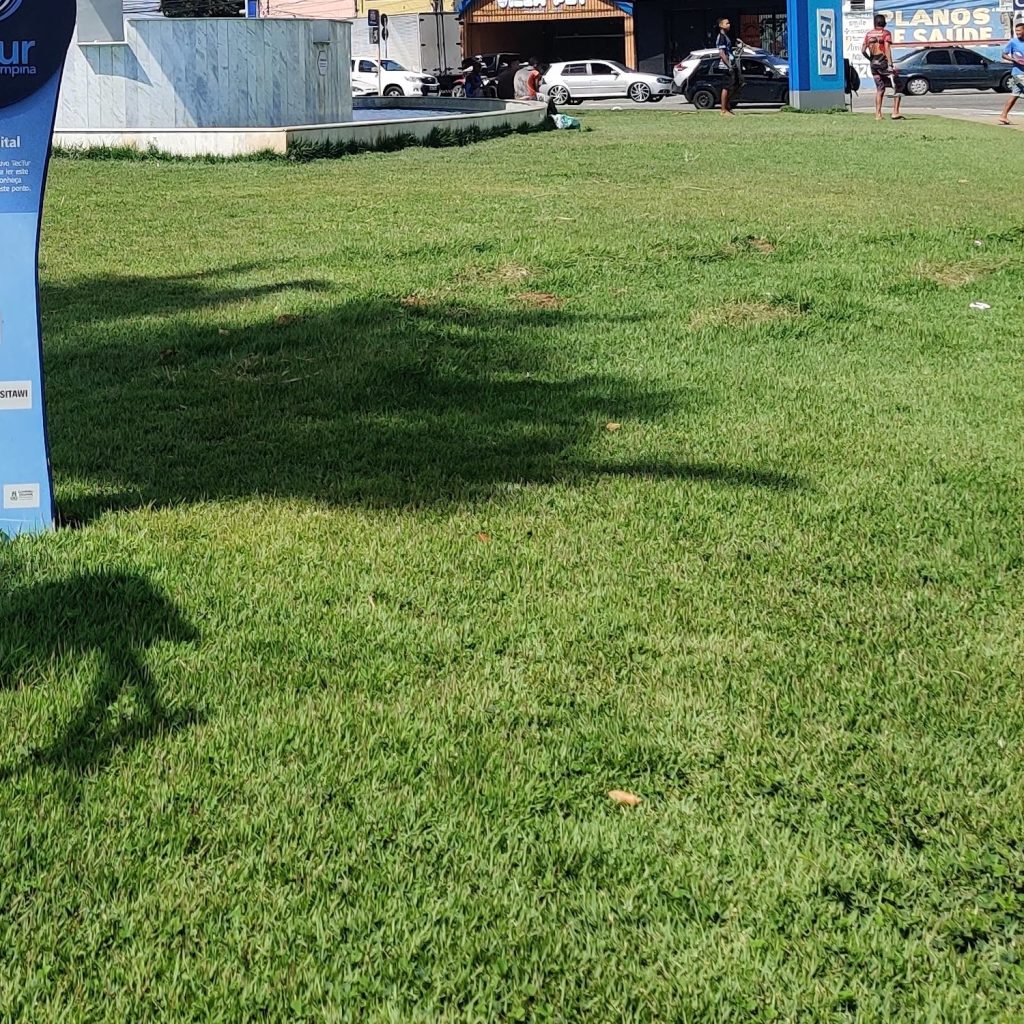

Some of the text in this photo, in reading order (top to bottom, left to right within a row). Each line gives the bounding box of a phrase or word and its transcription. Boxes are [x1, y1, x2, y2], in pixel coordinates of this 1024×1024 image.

[820, 15, 833, 69] SESI
[913, 25, 993, 43] SAÚDE
[0, 389, 28, 399] SITAWI
